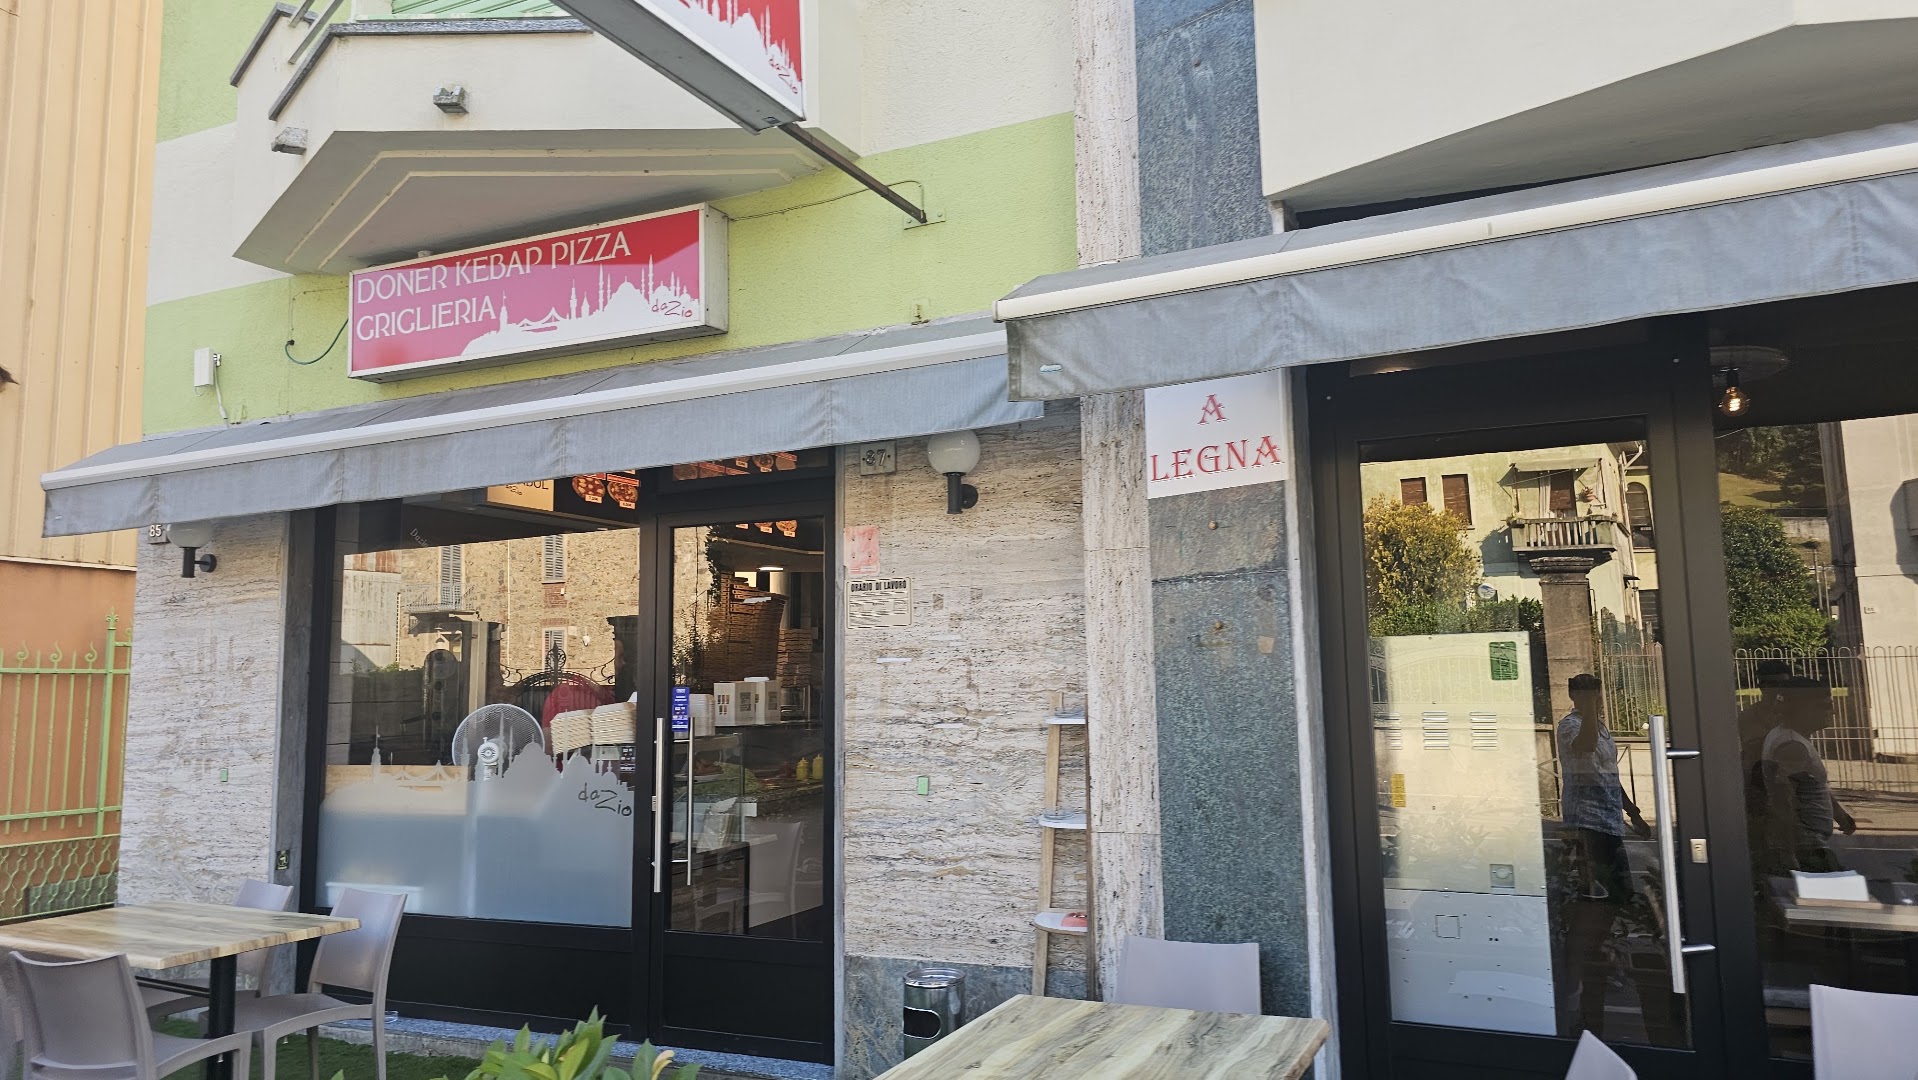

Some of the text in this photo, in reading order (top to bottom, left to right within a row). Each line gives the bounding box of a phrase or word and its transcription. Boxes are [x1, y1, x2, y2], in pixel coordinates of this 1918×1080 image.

[357, 231, 632, 305] DONER KEBAP PIZZA
[356, 295, 497, 341] GRIGLIERIA
[1198, 394, 1229, 425] A
[1150, 435, 1284, 482] LEGNA
[851, 579, 907, 593] ORARIO DI LAVORO
